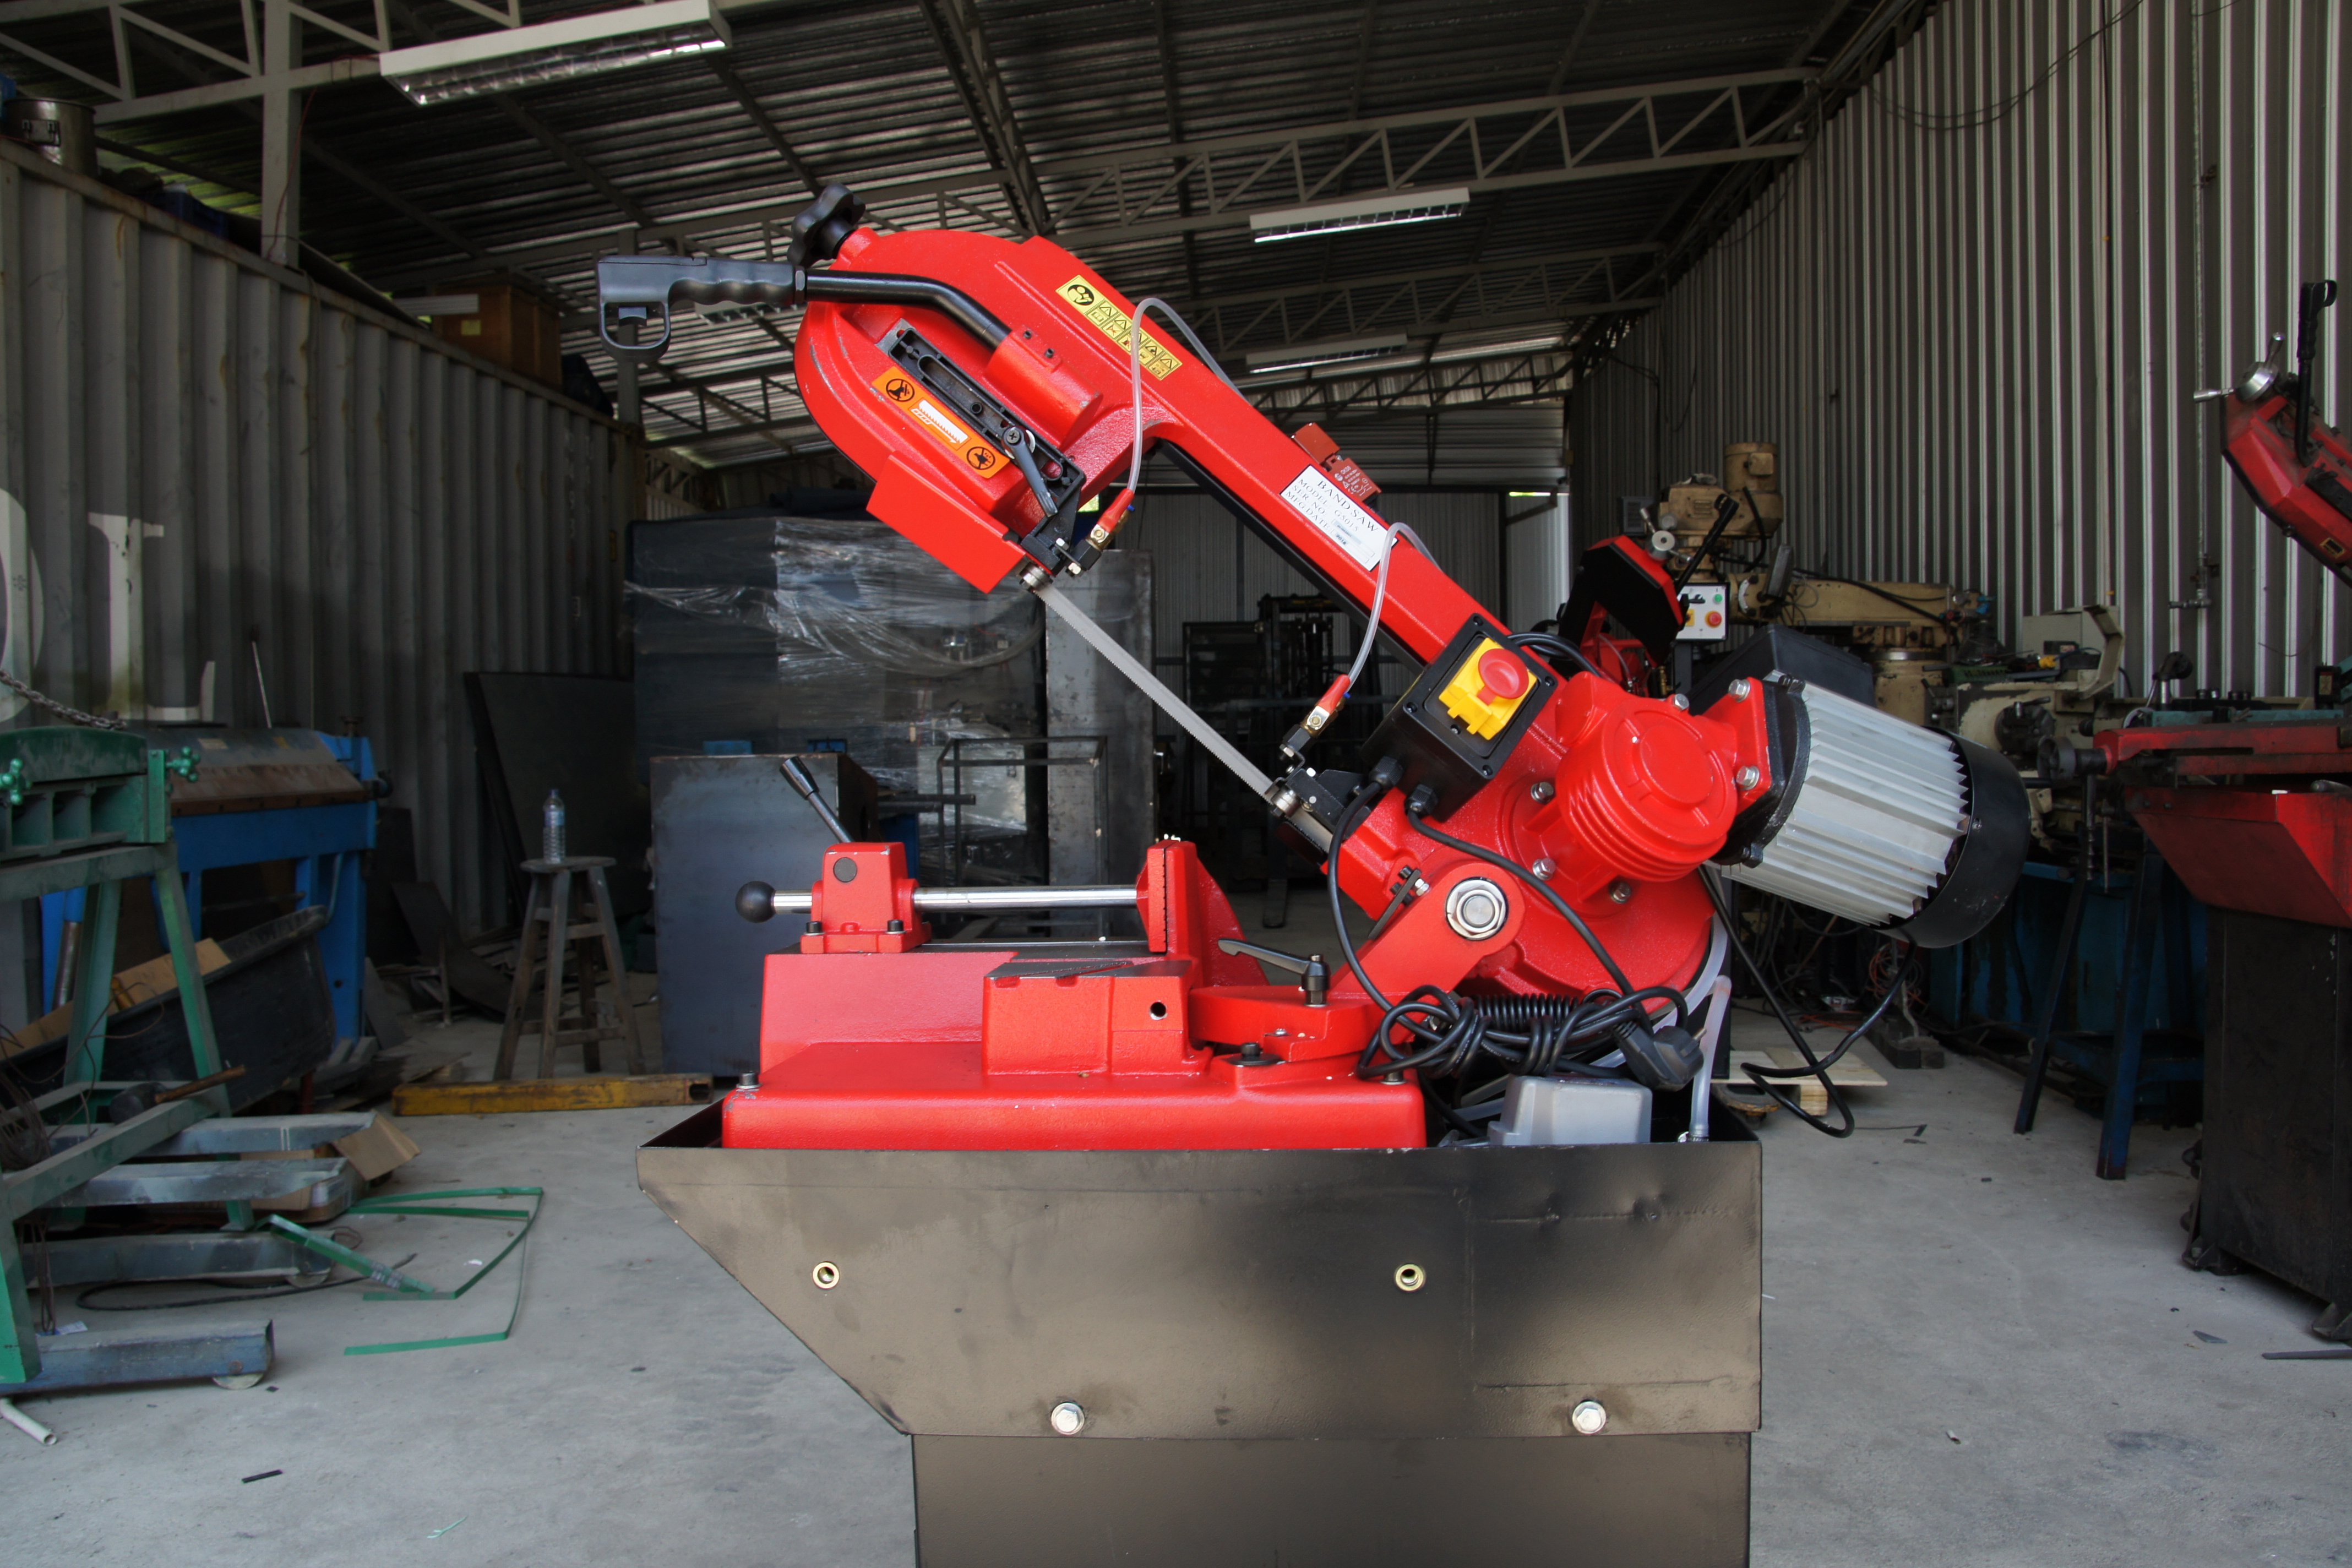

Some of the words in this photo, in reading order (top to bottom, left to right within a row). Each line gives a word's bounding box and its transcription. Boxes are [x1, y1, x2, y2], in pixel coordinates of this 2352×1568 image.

[1286, 491, 1305, 509] MFG
[1317, 480, 1351, 510] BAND
[1351, 509, 1378, 532] SAW
[1335, 510, 1359, 532] G5015
